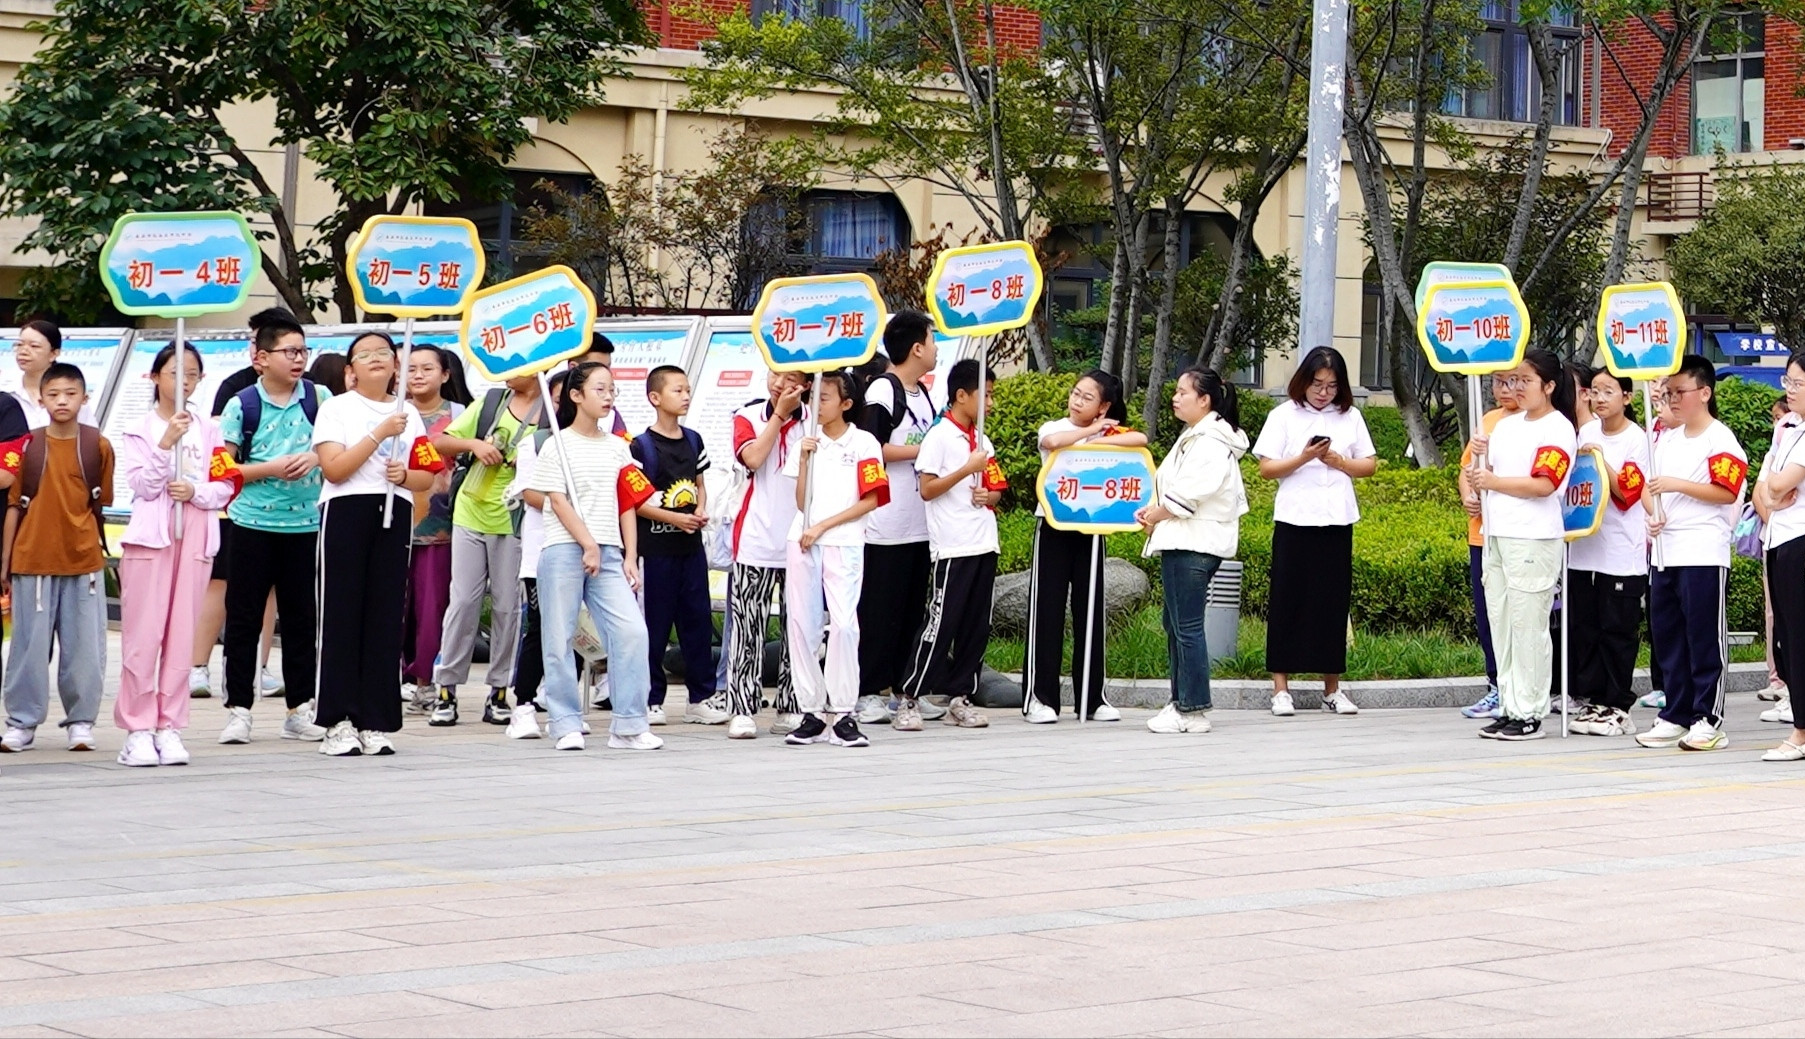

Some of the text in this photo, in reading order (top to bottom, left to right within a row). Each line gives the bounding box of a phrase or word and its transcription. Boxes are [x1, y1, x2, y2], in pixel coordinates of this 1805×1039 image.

[128, 257, 241, 290] 初一4班
[368, 258, 462, 289] 初一5班
[947, 274, 1024, 308] 初一8班
[480, 302, 576, 353] 初一6班
[772, 311, 864, 343] 初一7班
[1436, 314, 1511, 342] 初一10班
[1611, 318, 1669, 345] 初一11班
[1057, 476, 1141, 501] 初一8班
